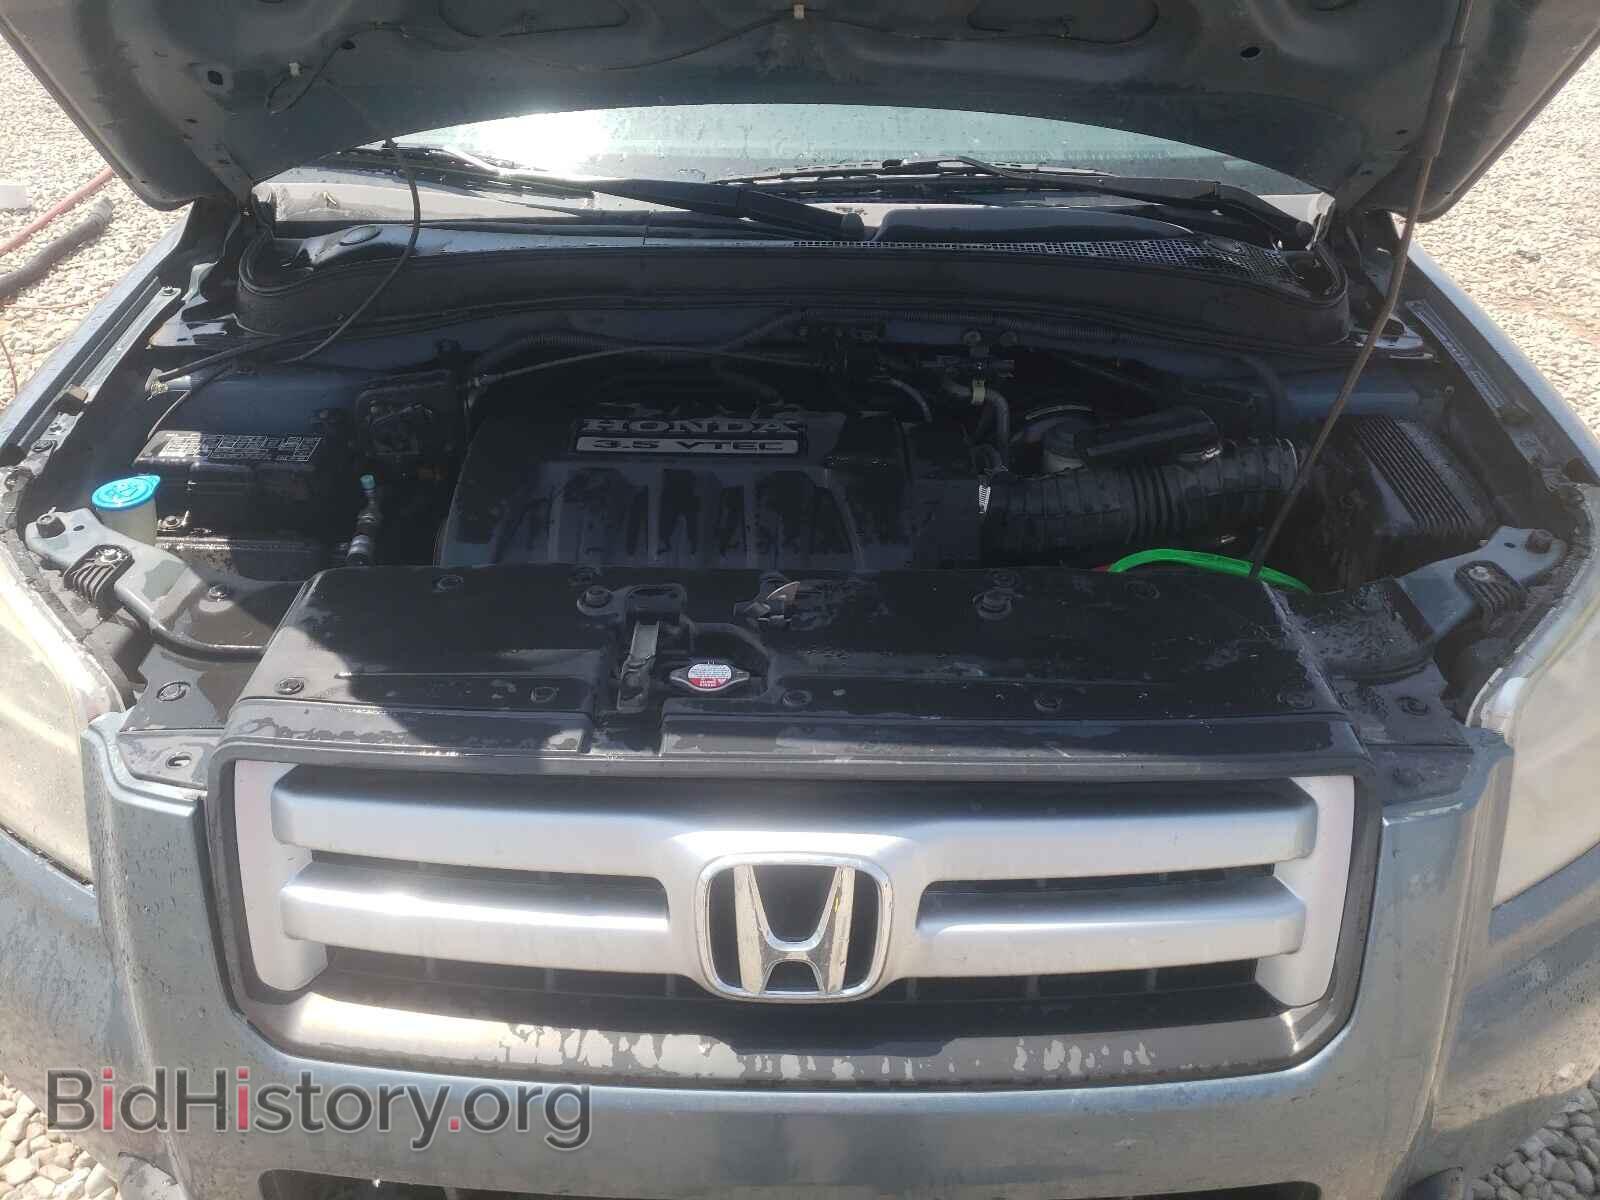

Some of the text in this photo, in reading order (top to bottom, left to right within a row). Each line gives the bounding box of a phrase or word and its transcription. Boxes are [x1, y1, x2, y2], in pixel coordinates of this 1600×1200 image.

[582, 418, 799, 433] HONDA
[592, 439, 784, 451] 3.5 VTEC
